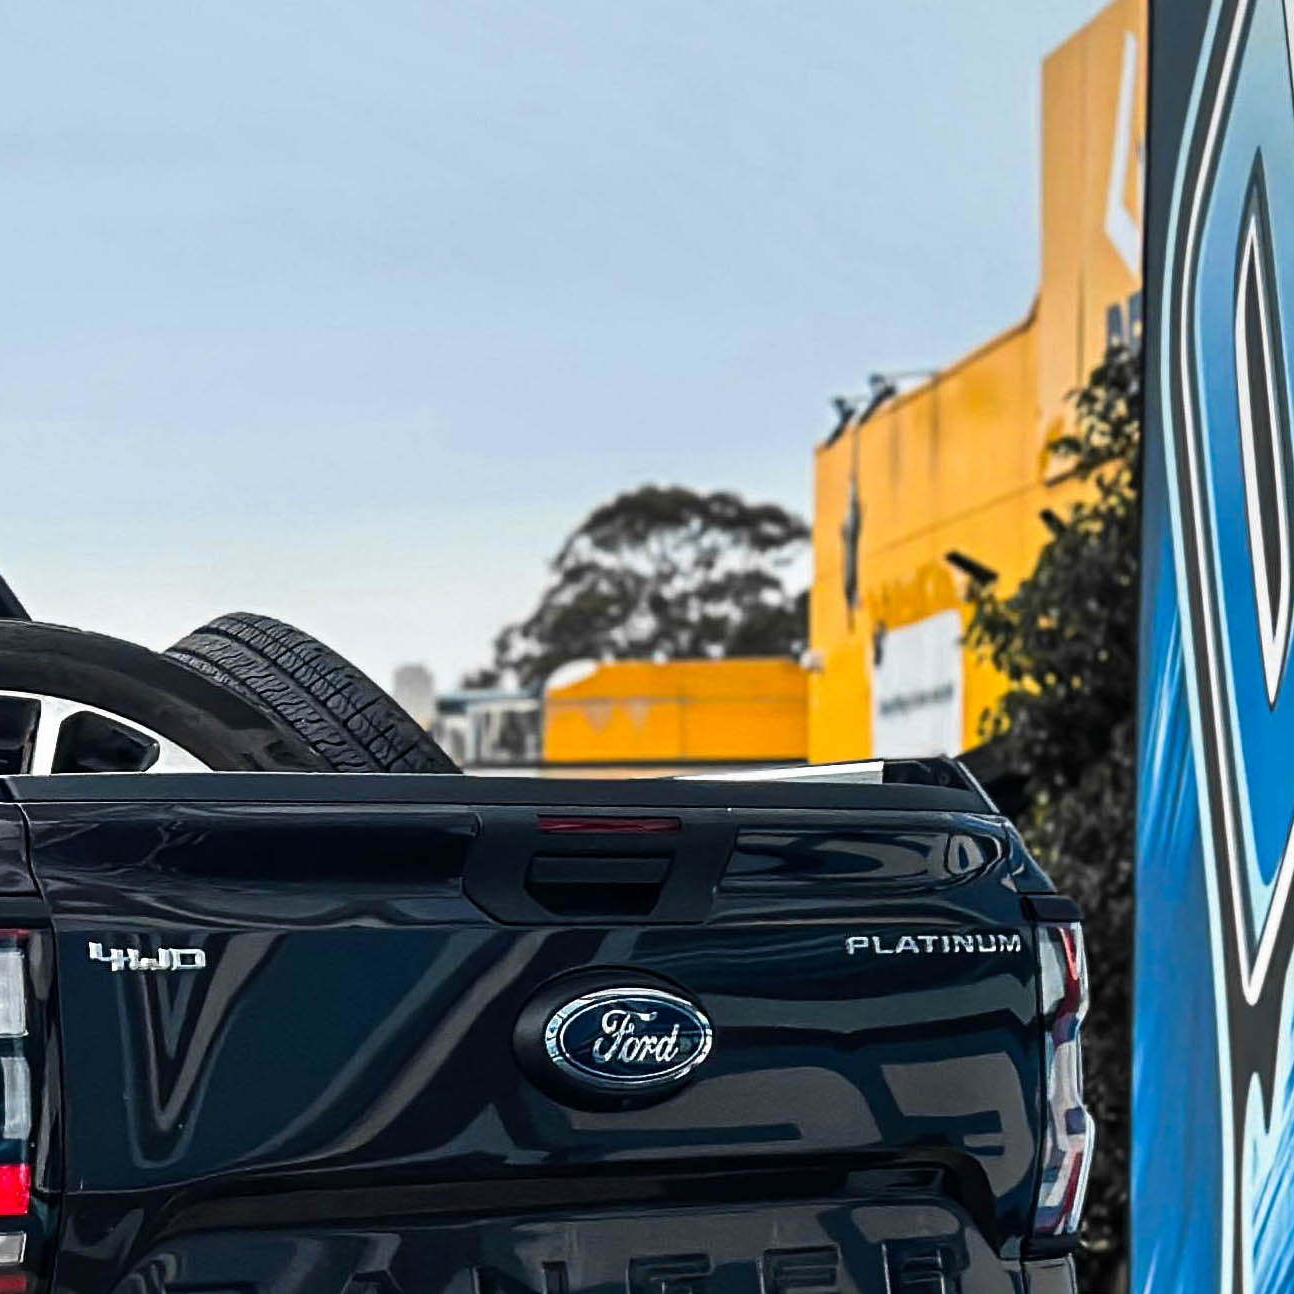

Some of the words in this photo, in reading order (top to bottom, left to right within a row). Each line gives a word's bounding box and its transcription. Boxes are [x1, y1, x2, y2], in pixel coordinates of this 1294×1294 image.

[88, 941, 207, 972] 4WD
[844, 935, 1022, 955] PLATINUM
[592, 1009, 682, 1065] Ford
